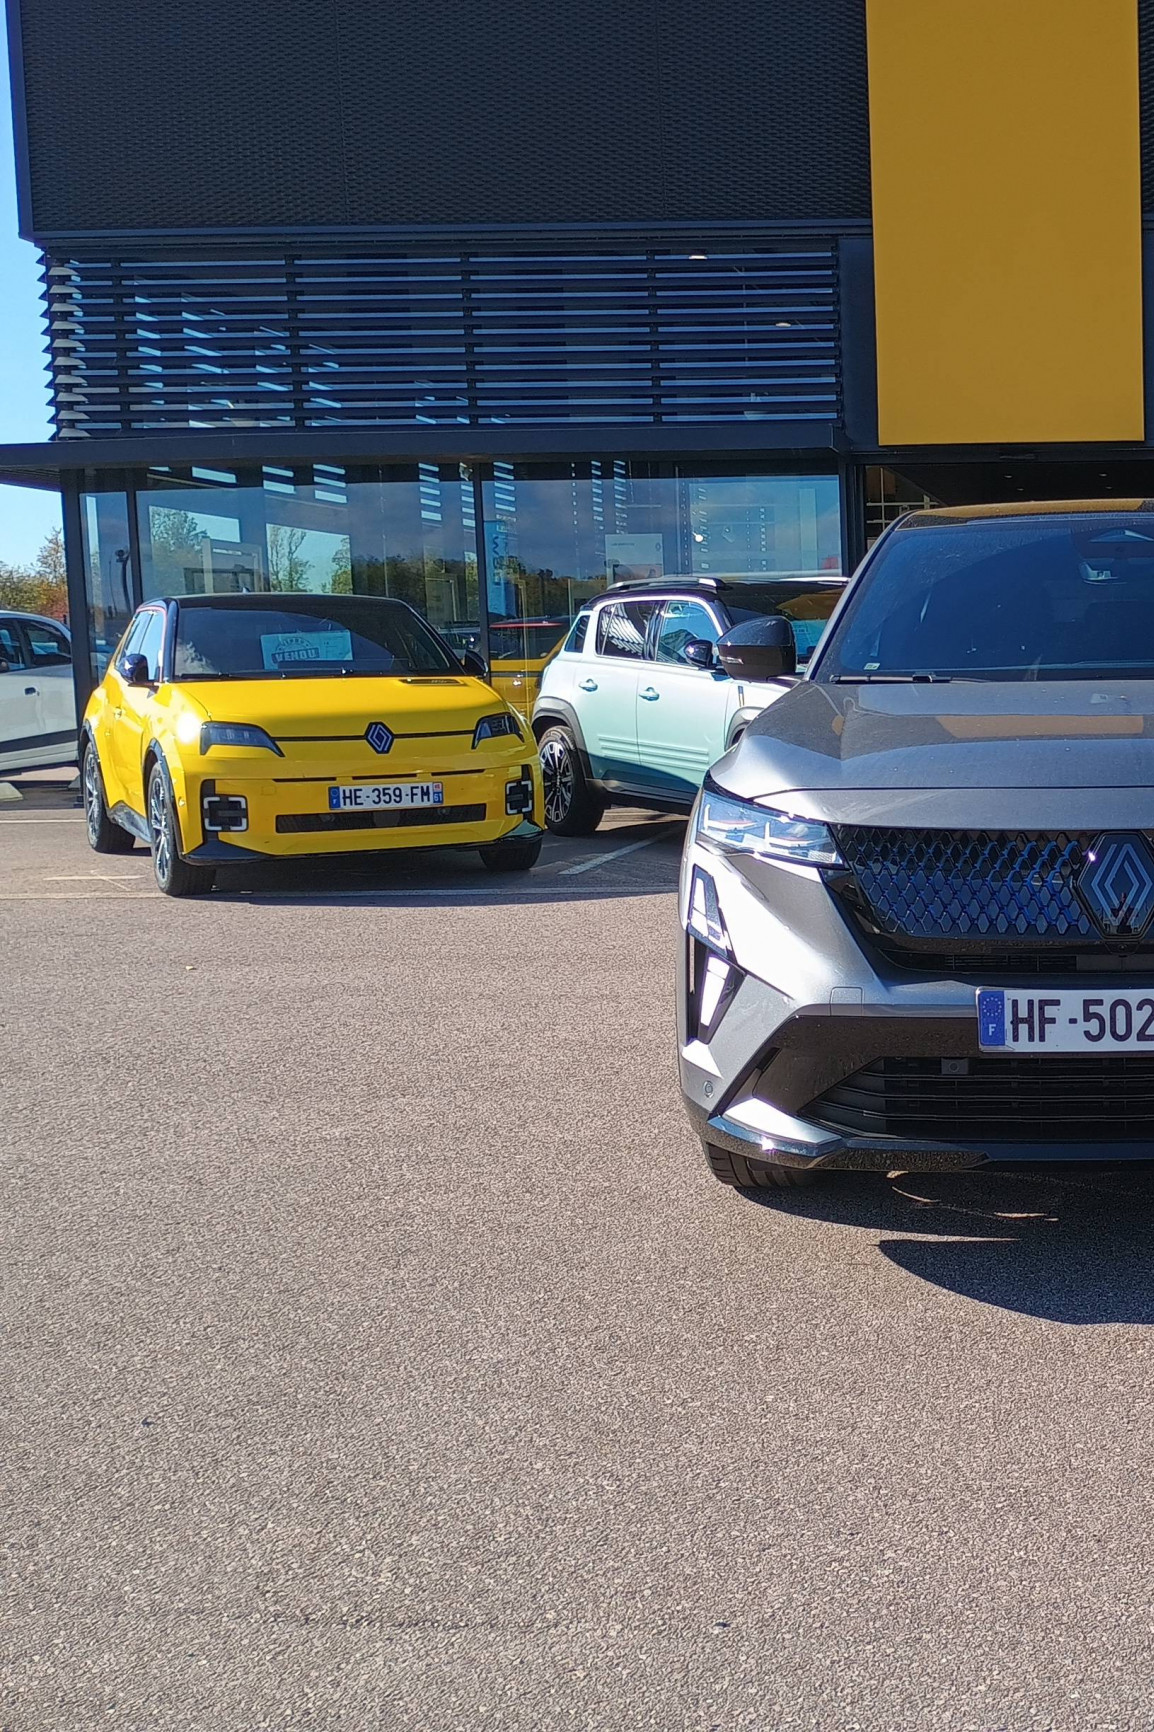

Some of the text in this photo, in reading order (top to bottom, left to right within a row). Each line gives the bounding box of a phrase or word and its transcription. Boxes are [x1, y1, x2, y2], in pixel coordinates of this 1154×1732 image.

[275, 648, 317, 662] VENDU
[342, 785, 431, 806] HE-359-FM
[988, 1024, 996, 1036] F
